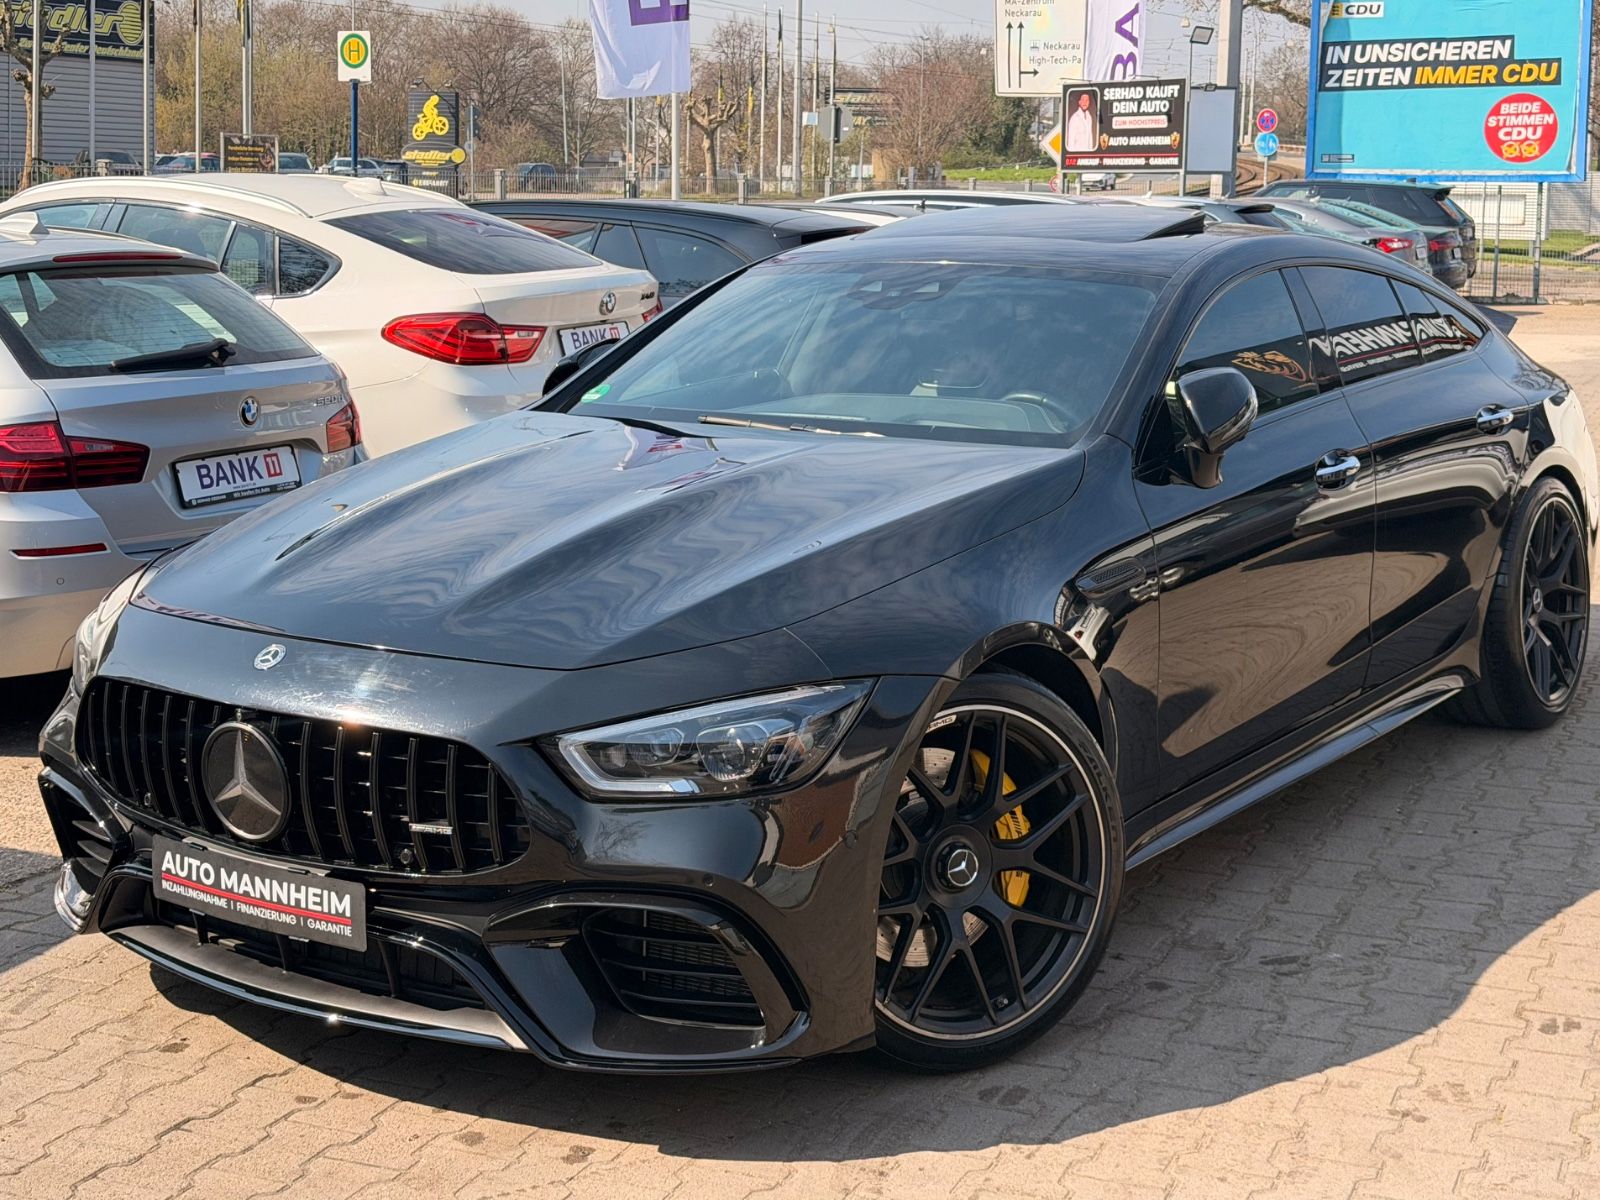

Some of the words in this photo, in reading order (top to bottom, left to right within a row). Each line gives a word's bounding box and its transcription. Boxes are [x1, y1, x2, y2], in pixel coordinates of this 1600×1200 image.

[1004, 9, 1042, 17] Neckarau
[1345, 4, 1381, 15] CDU
[348, 41, 360, 61] H
[1043, 42, 1080, 50] Neckarau
[1325, 45, 1351, 65] IN
[1354, 39, 1512, 64] UNSICHEREN
[1325, 66, 1412, 88] ZEITEN
[1414, 64, 1498, 85] IMMER
[1502, 62, 1559, 83] CDU
[1103, 86, 1144, 100] SERHAD
[1145, 84, 1180, 98] KAUFT
[1112, 101, 1138, 113] DEIN
[1139, 100, 1170, 113] AUTO
[1500, 102, 1541, 114] BEIDE
[1487, 113, 1554, 127] STIMMEN
[1108, 136, 1128, 146] AUTO
[1129, 135, 1172, 146] MANNHEIM
[1498, 126, 1543, 140] CDU
[571, 328, 607, 350] BANK
[195, 455, 264, 490] BANK
[264, 454, 282, 477] 11
[161, 850, 215, 886] AUTO
[220, 867, 351, 917] MANNHEIM
[162, 879, 228, 908] INZAHLUNGNAHME
[236, 902, 297, 925] FINANZIERUNG
[307, 918, 352, 937] GARANTIE
